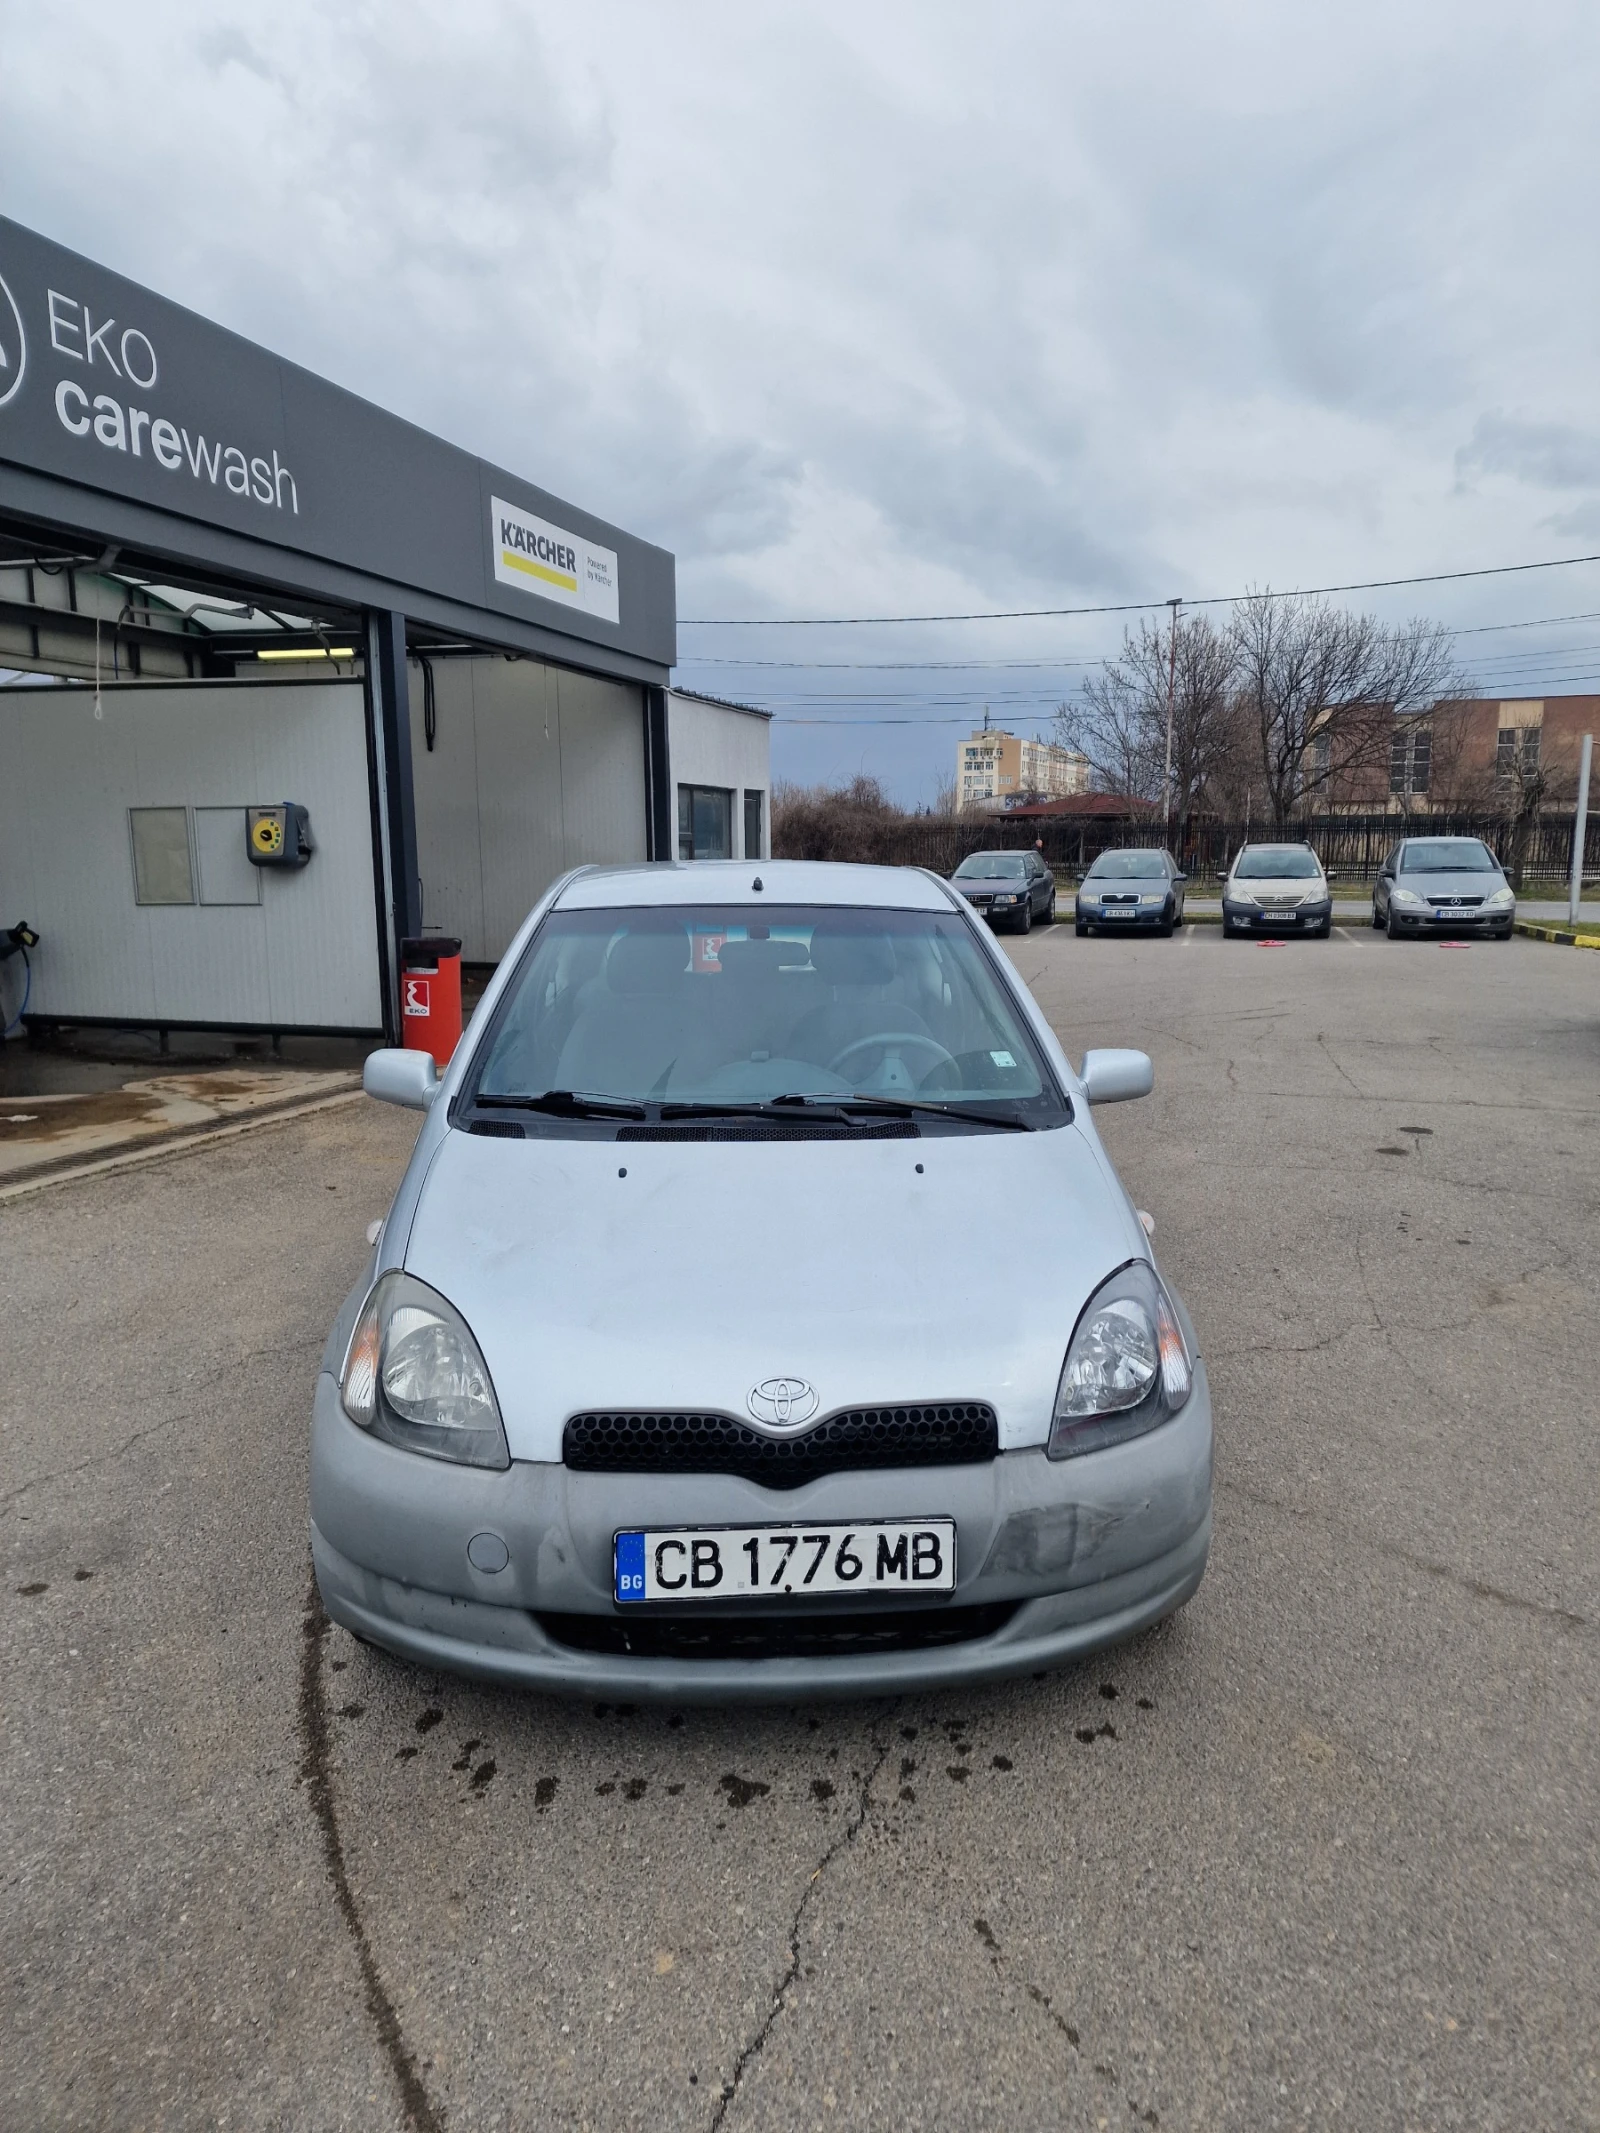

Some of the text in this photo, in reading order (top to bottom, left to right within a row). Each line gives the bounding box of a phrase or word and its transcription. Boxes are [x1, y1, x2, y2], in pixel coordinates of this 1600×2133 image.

[47, 288, 157, 389] EKO
[54, 379, 299, 515] carewash
[500, 518, 577, 574] KÄRCHER
[620, 1574, 643, 1590] BG
[655, 1531, 943, 1590] CB 1776 MB
